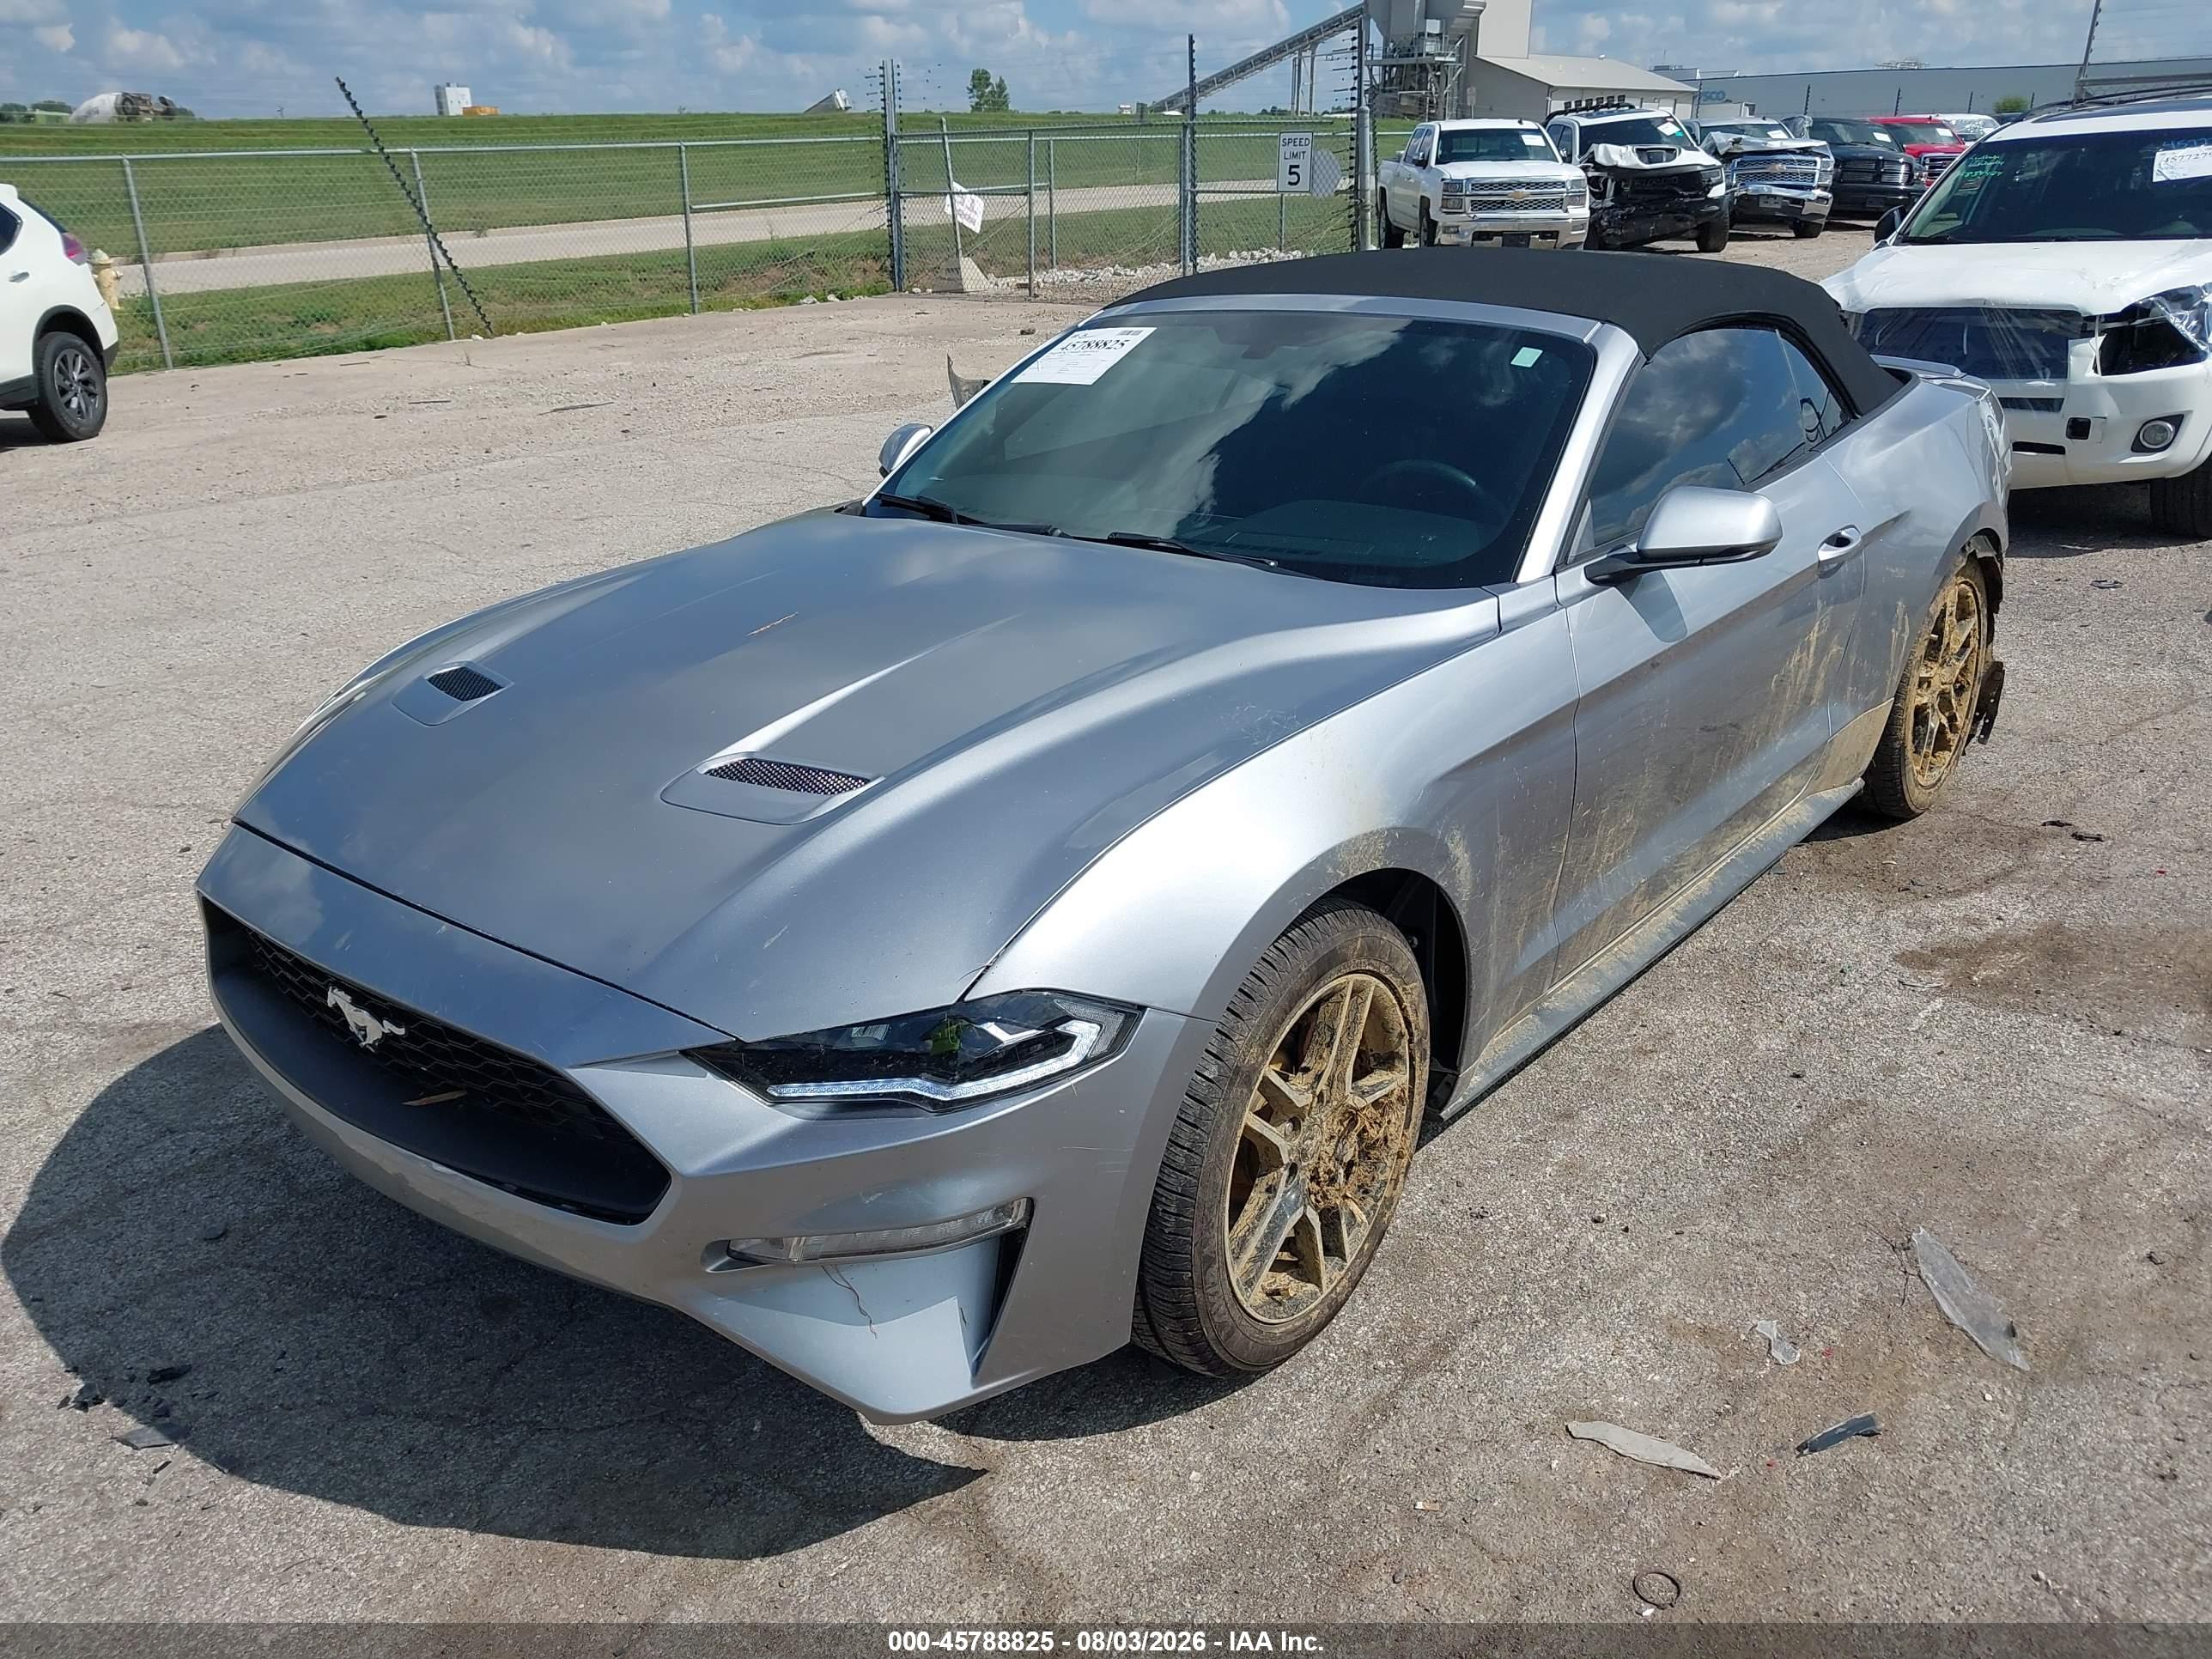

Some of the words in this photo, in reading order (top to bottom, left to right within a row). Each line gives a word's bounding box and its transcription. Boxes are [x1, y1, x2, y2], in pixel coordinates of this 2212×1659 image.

[1282, 137, 1310, 147] SPEED
[1284, 150, 1306, 161] LIMIT
[1287, 164, 1301, 186] 5
[1060, 339, 1131, 351] 45788825
